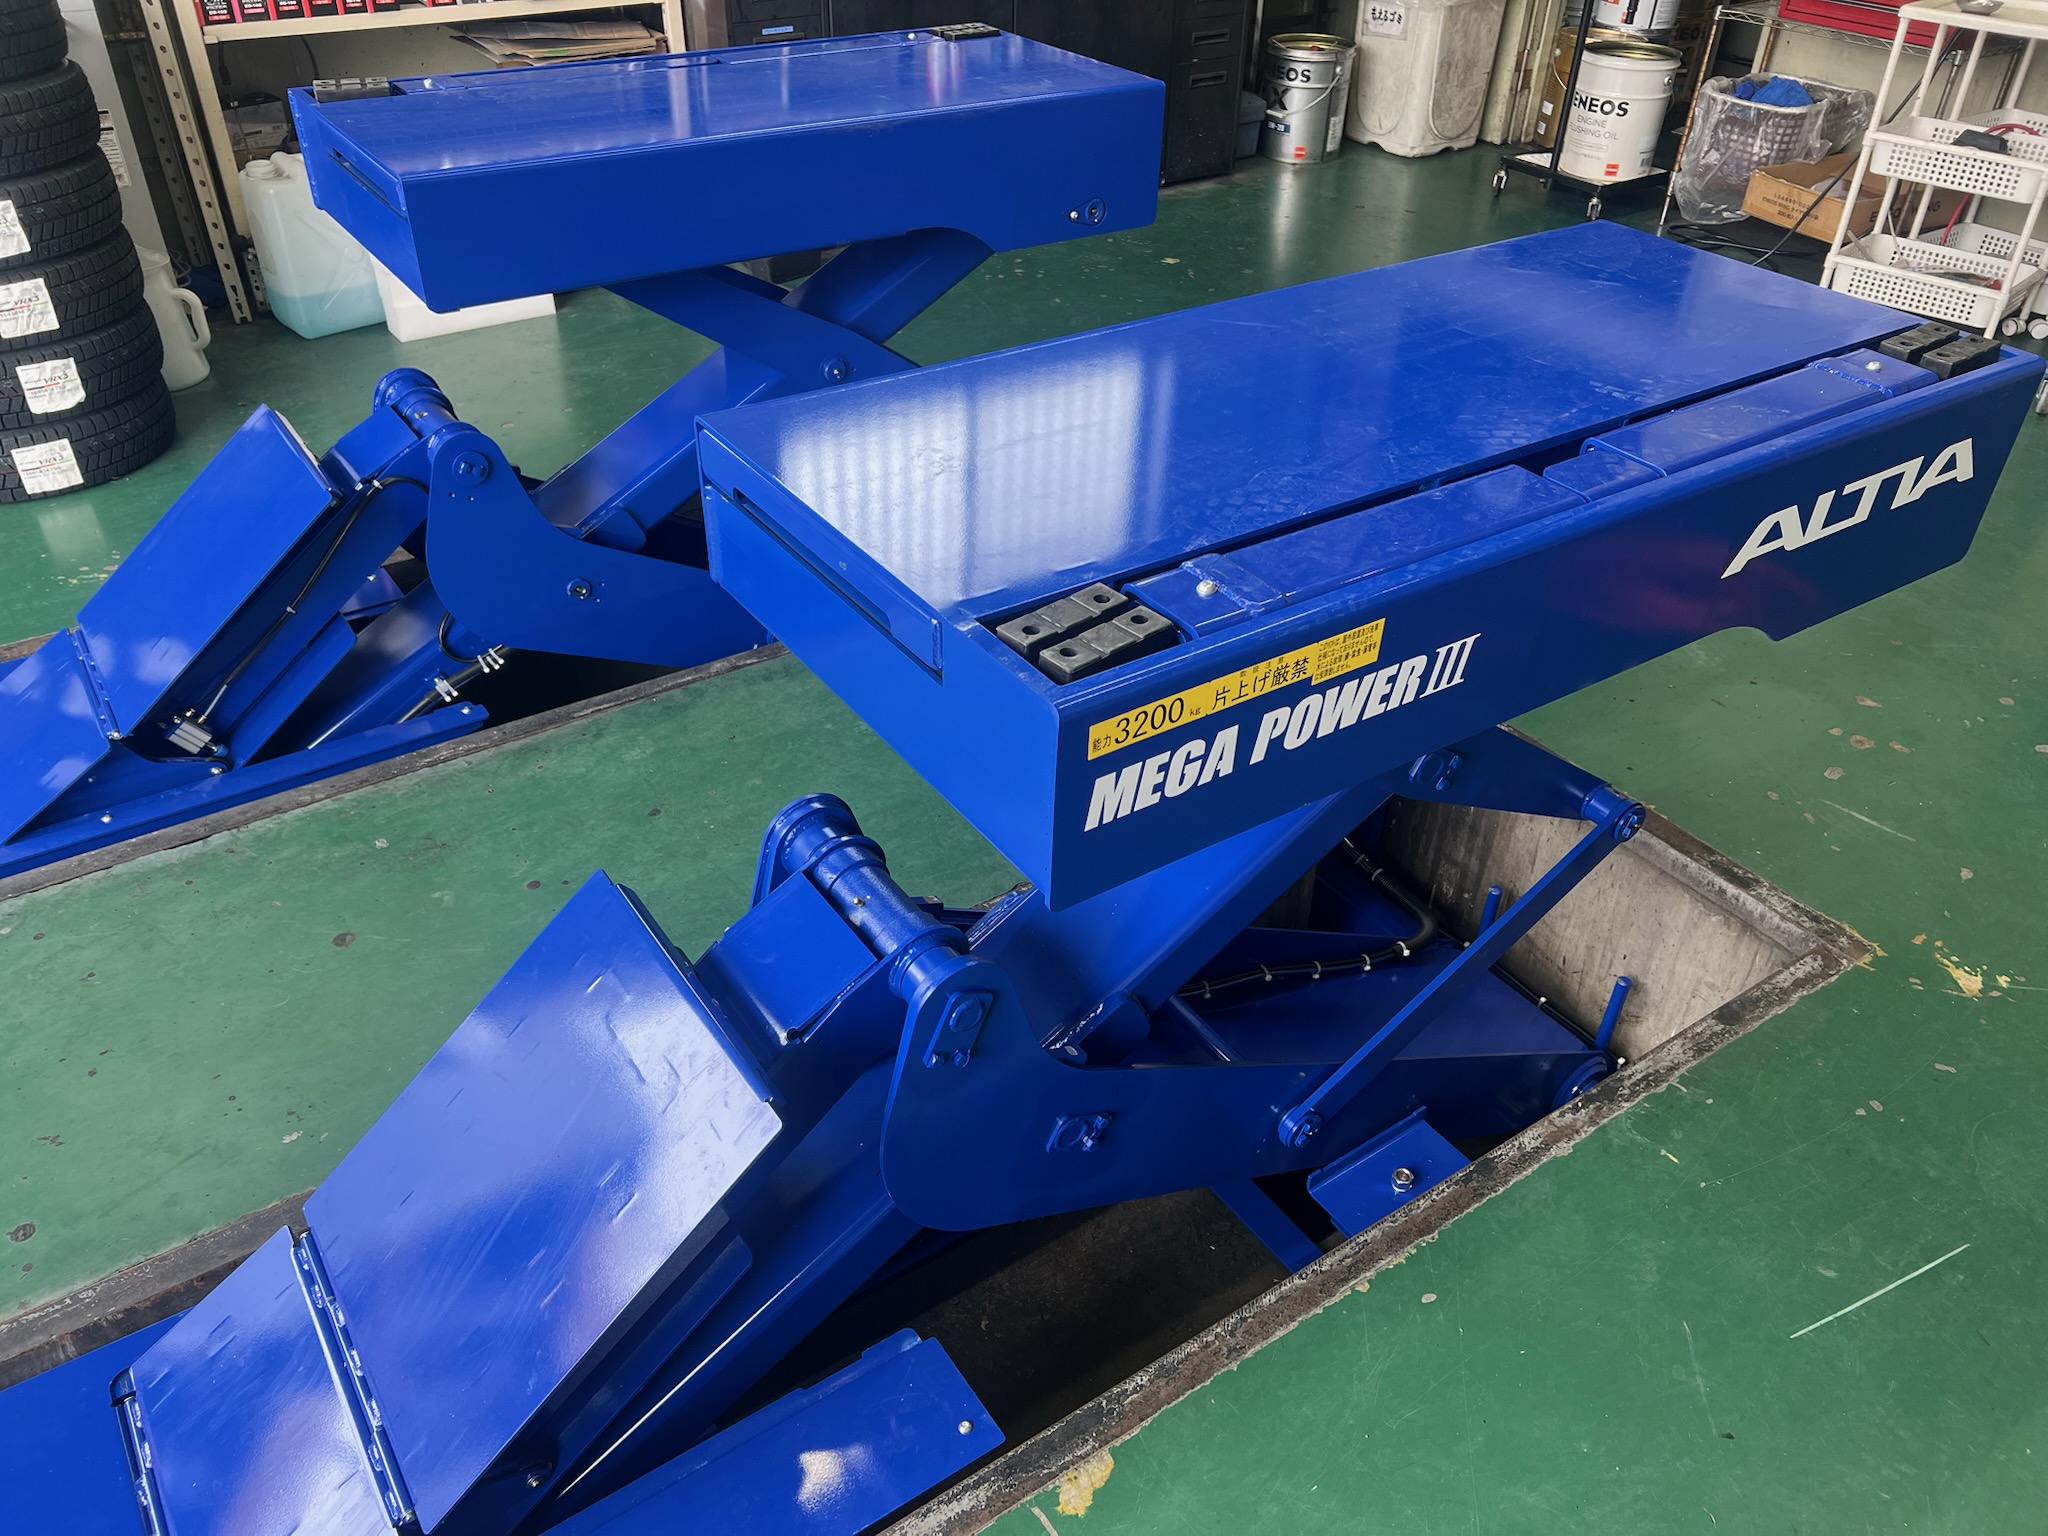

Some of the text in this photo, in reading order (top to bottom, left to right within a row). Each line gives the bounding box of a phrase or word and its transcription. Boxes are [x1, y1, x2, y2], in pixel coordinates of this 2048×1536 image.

[1577, 114, 1608, 129] ENGINE
[1603, 131, 1619, 140] OIL
[1720, 438, 1974, 579] ALTIA
[1212, 655, 1311, 710] 片上げ厳禁
[1084, 724, 1240, 833] MEGA
[1249, 655, 1428, 766] POWER
[1092, 697, 1202, 753] 能力 3200 kg
